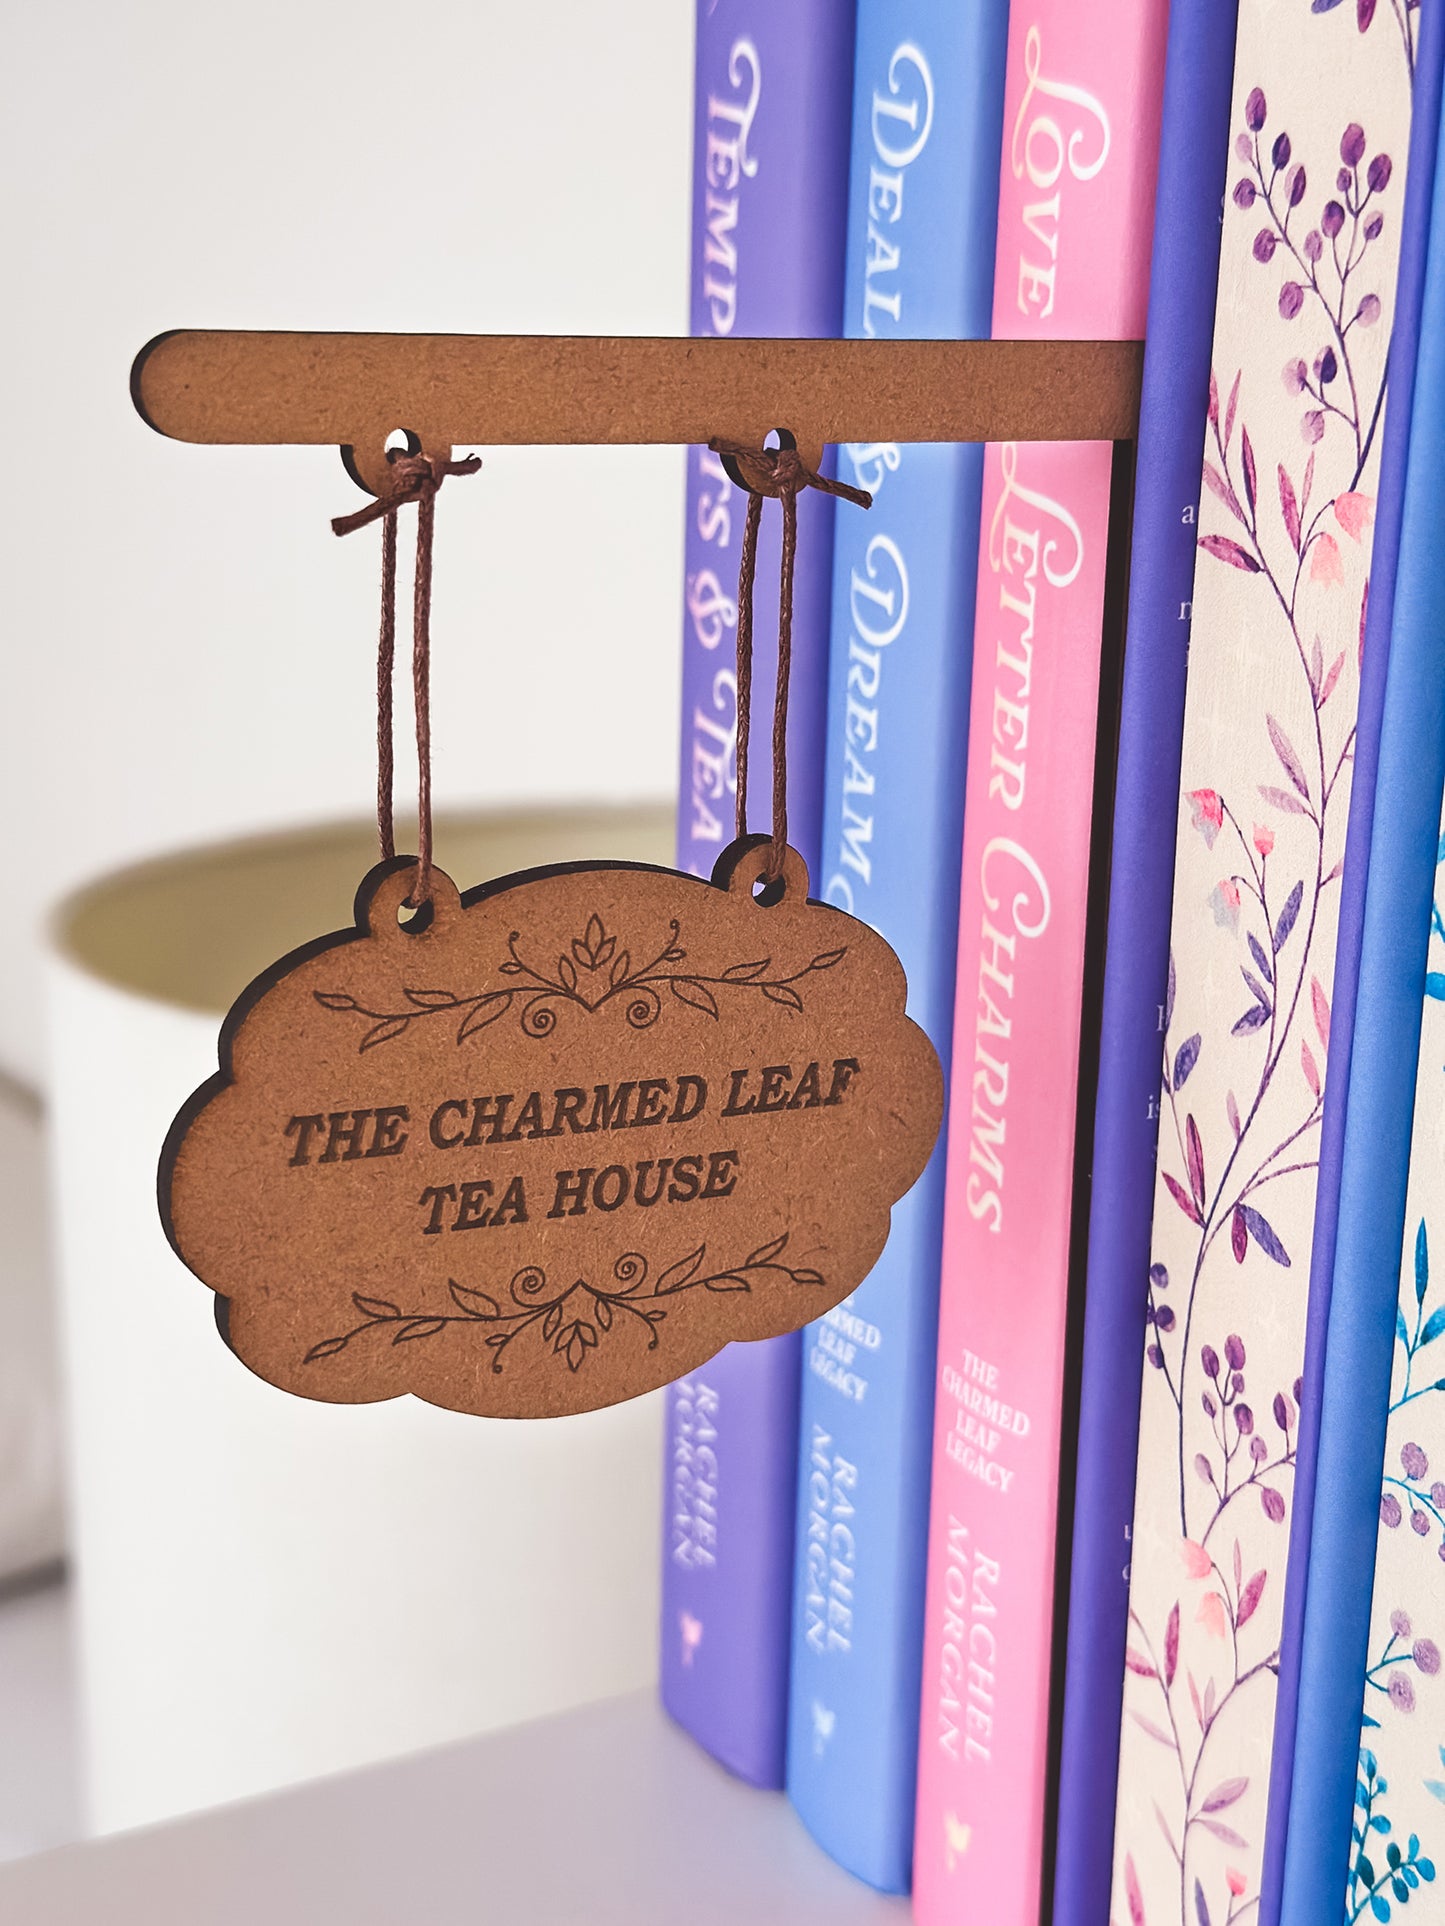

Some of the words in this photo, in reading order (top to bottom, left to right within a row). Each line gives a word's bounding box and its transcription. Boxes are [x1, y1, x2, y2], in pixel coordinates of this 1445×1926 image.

[863, 42, 935, 338] DEAL
[1012, 24, 1110, 319] LOVE
[698, 34, 761, 547] TEMPTS
[688, 568, 739, 651] &
[841, 534, 909, 886] DREAM
[989, 442, 1083, 811] LETTER
[691, 668, 738, 843] TEA
[284, 1105, 410, 1167] THE
[428, 1074, 709, 1149] CHARMED
[721, 1057, 861, 1118] LEAF
[966, 837, 1051, 1234] CHARMS
[419, 1176, 529, 1234] TEA
[547, 1150, 741, 1219] HOUSE
[942, 1364, 1030, 1438] CHARMED
[945, 1431, 1014, 1493] LEGACY
[955, 1408, 1001, 1456] LEAF
[961, 1348, 999, 1391] THE
[804, 1424, 833, 1655] MORGAN
[827, 1454, 859, 1654] RACHEL
[937, 1514, 970, 1762] MORGAN
[964, 1548, 1001, 1763] RACHEL
